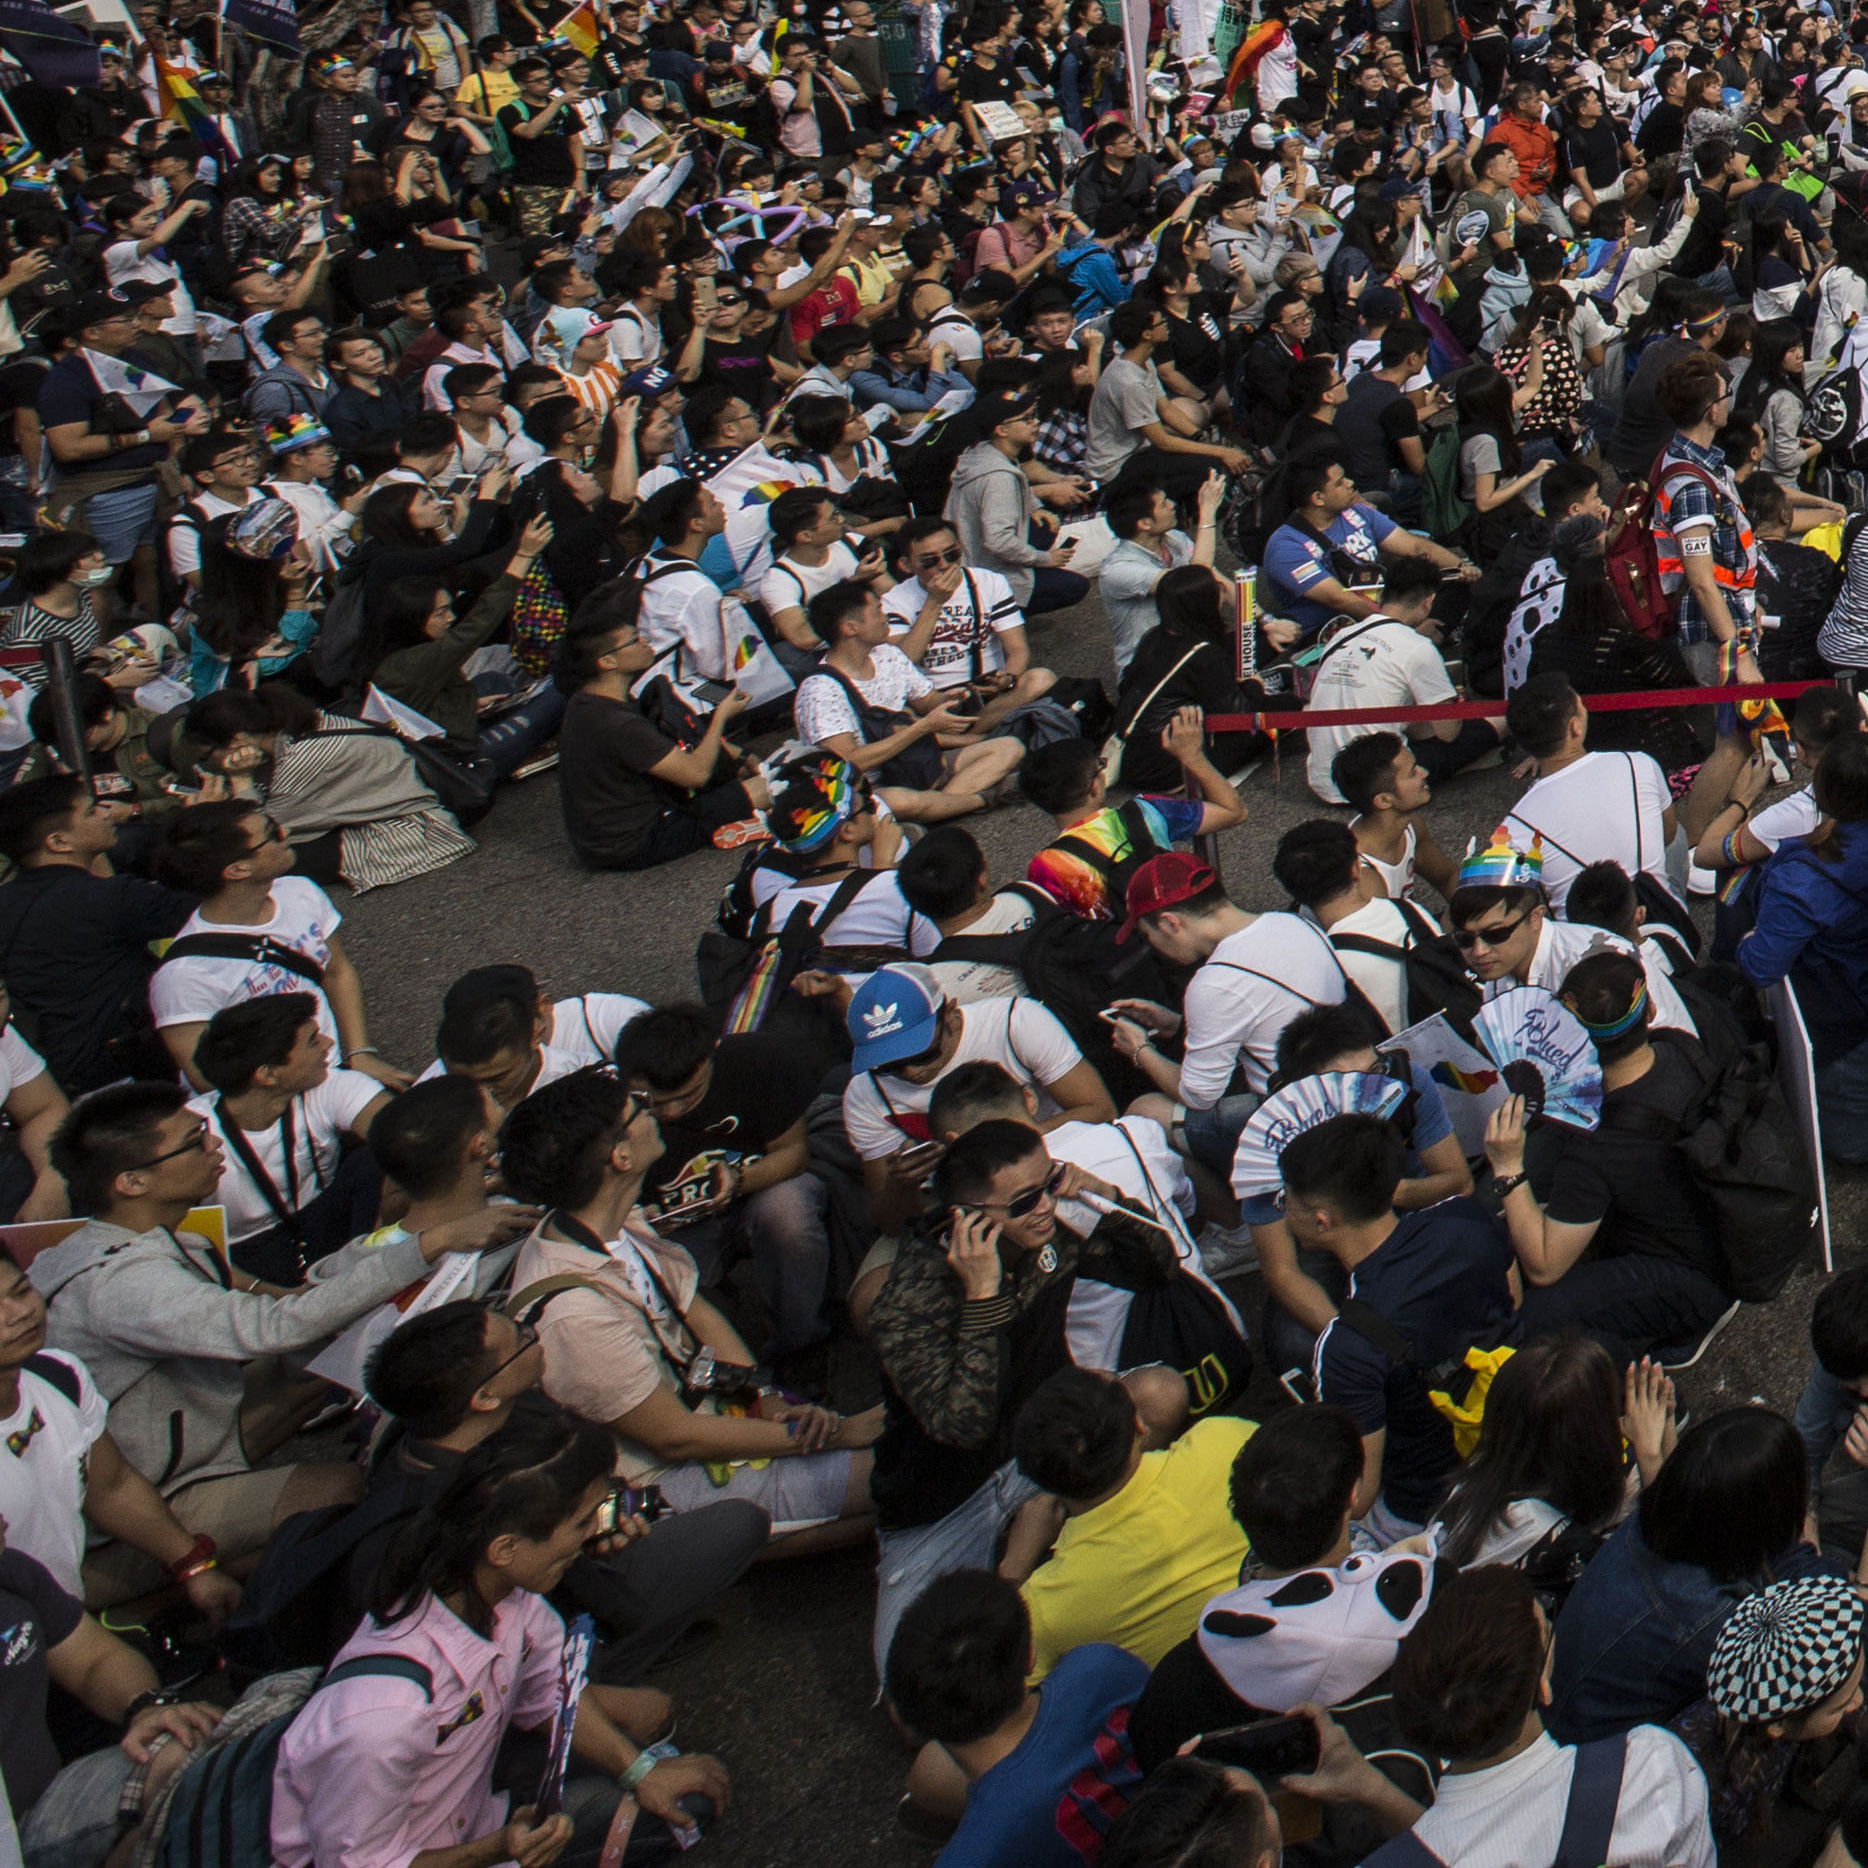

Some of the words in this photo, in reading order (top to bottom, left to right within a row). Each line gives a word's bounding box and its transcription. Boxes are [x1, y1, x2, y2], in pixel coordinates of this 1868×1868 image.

[1685, 541, 1707, 552] GAY
[1241, 623, 1255, 663] HOUSE
[866, 1018, 904, 1040] adidas
